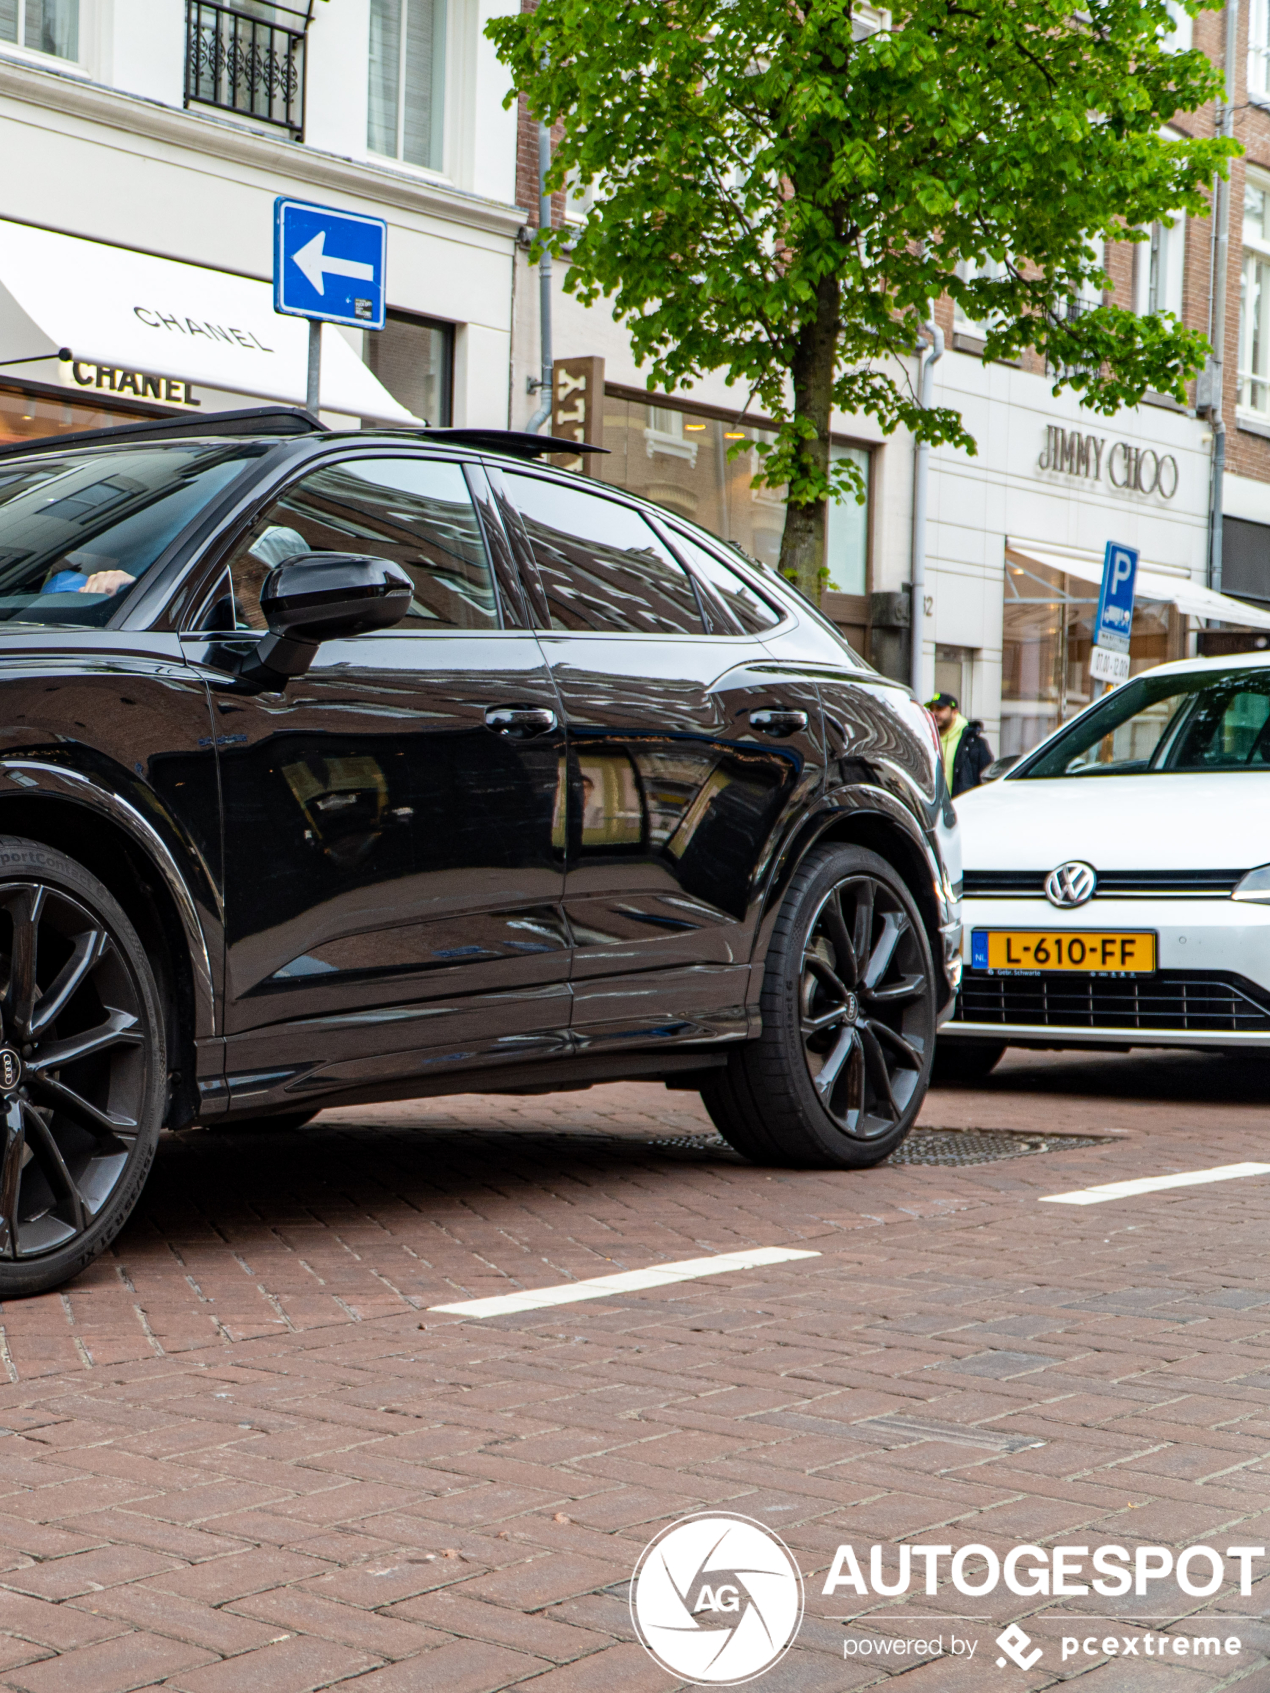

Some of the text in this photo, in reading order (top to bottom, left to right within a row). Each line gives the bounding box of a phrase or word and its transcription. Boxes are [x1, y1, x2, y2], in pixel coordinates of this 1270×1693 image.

[133, 306, 275, 353] CHANEL
[72, 361, 202, 406] CHANEL
[1038, 424, 1179, 499] JIMMY CHOO
[1111, 550, 1132, 595] P
[975, 954, 987, 963] NL
[1006, 938, 1136, 966] L-610-FF
